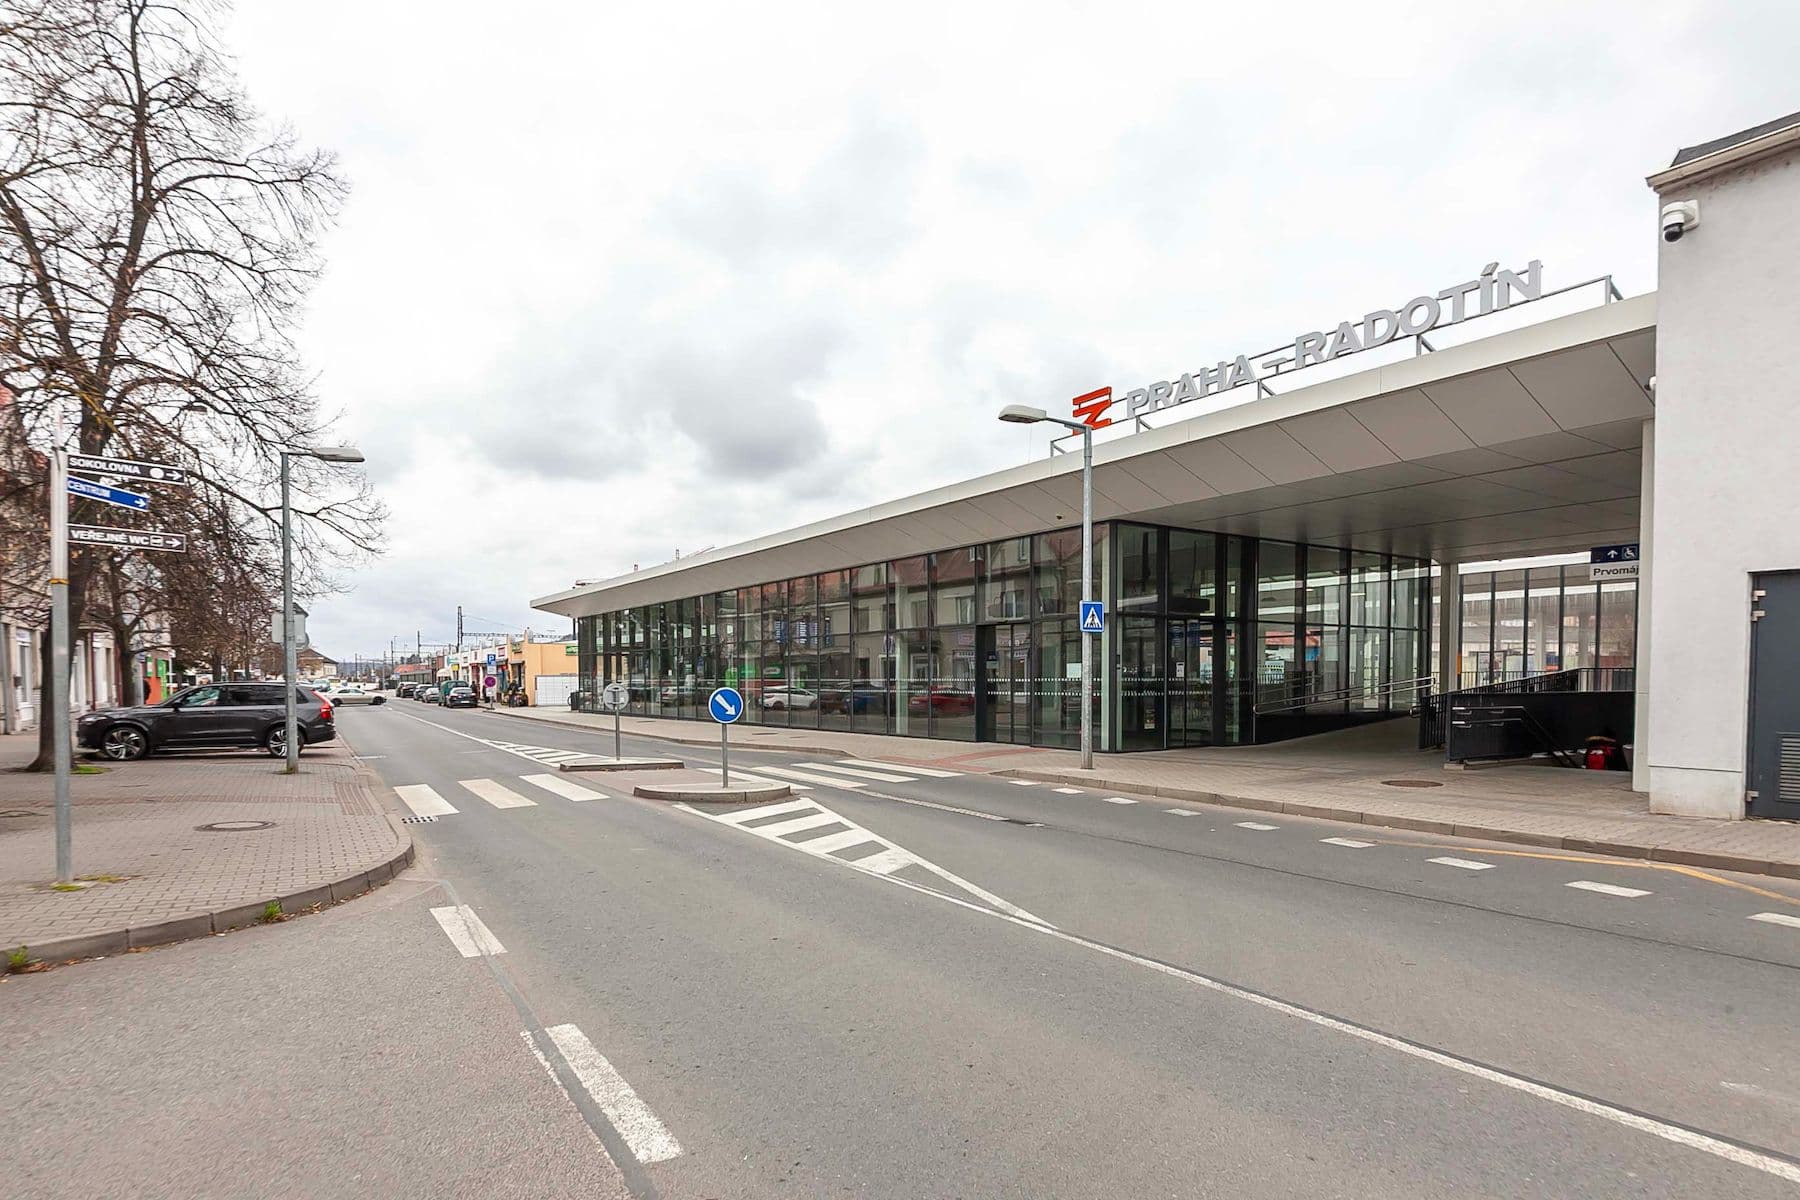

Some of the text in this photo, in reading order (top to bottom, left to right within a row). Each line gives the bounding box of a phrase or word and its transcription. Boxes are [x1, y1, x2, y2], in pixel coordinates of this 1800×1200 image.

[1295, 259, 1541, 369] RADOTÍN
[69, 457, 141, 474] SOKOLOVNA
[68, 480, 111, 498] CENTRUM
[71, 529, 149, 545] VEŘEJNÉ WC
